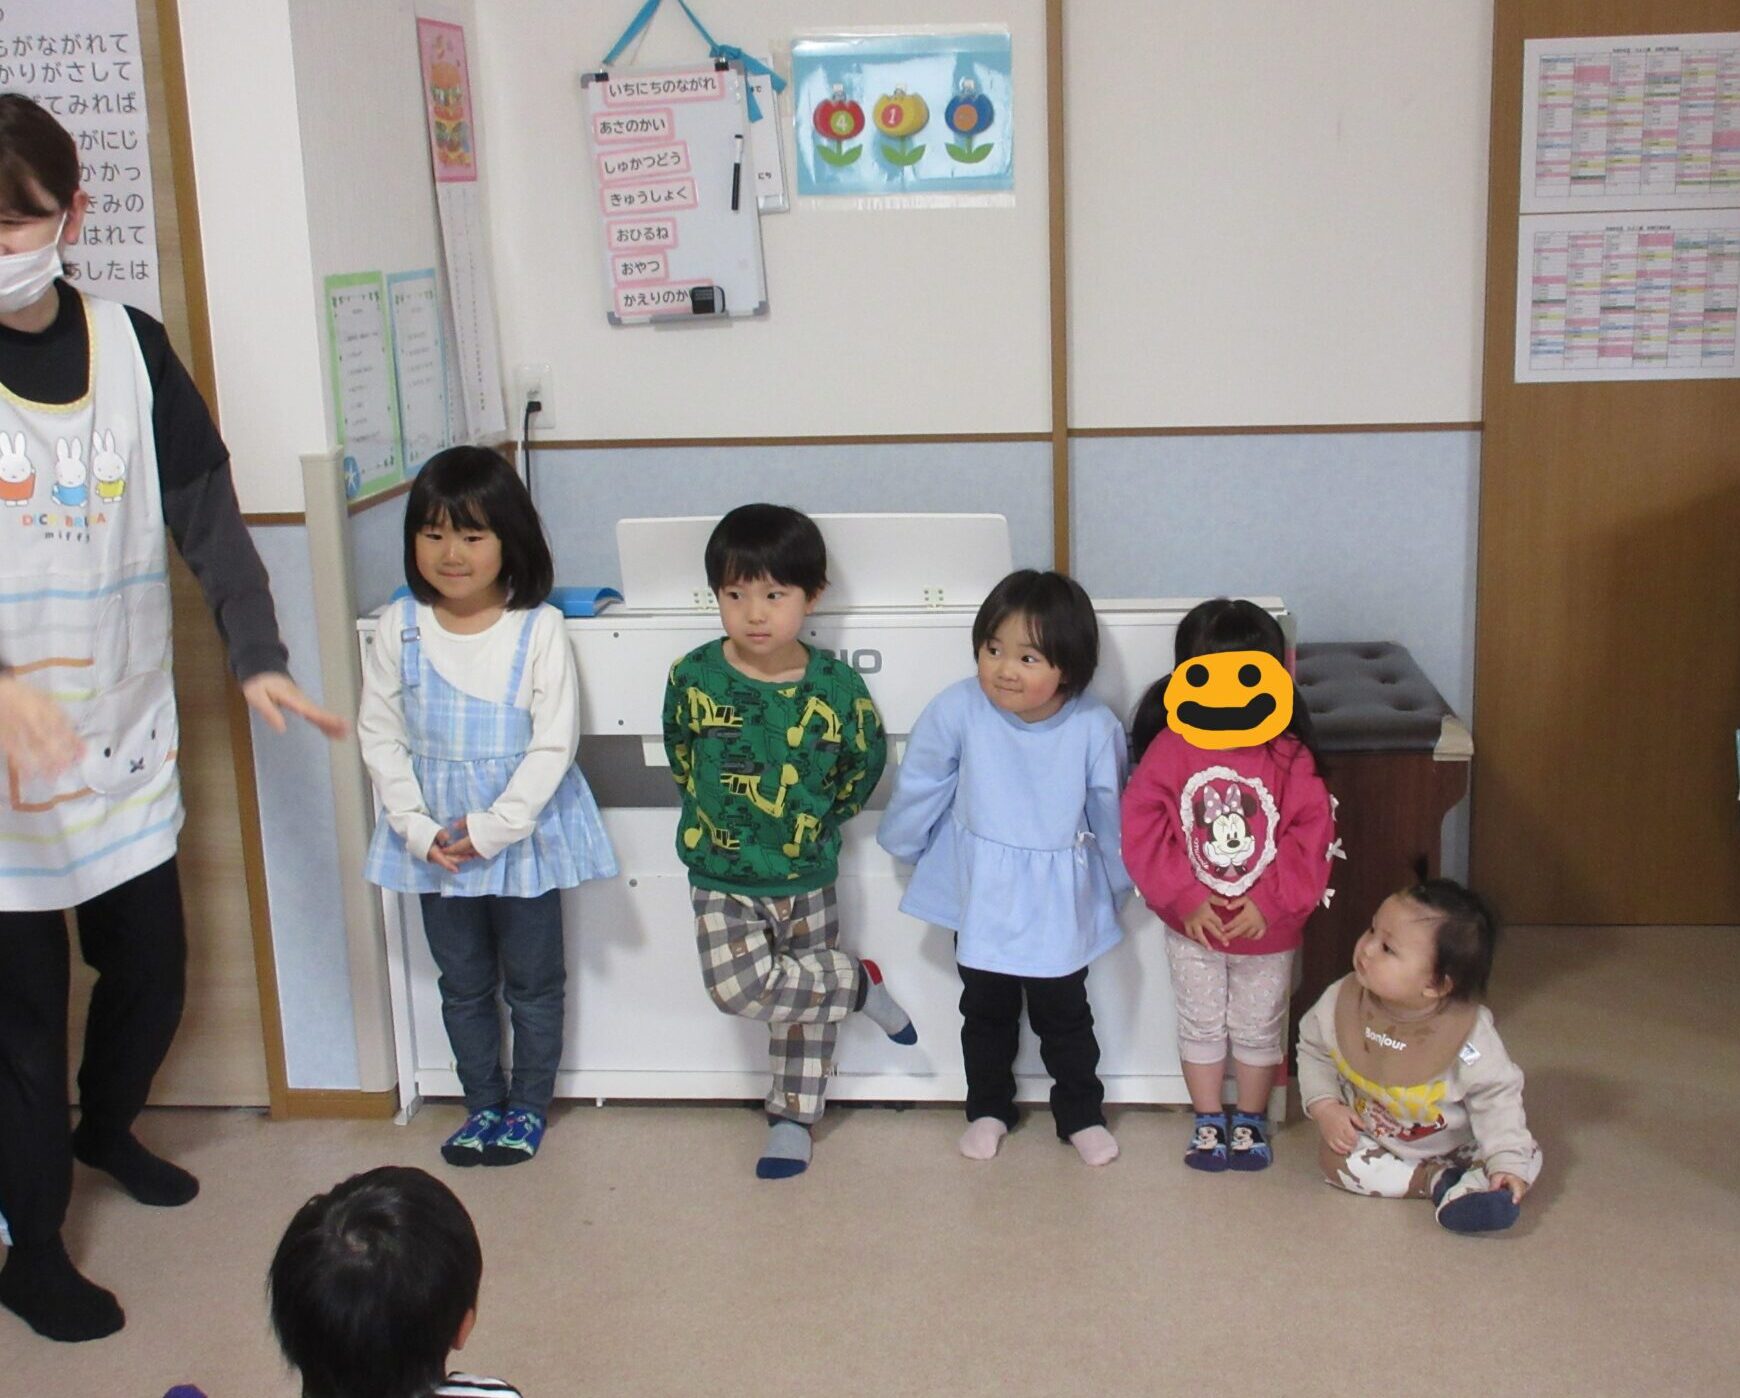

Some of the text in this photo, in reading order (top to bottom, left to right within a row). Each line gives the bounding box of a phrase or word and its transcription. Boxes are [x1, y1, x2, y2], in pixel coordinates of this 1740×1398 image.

[609, 77, 716, 98] いちにちのながれ
[32, 92, 137, 115] てみれば
[600, 118, 665, 135] あさのかい
[888, 108, 896, 125] 1
[71, 130, 138, 151] がにじ
[604, 151, 682, 175] しゅかつどう
[610, 186, 688, 207] きゅうしょく
[616, 226, 669, 242] おひるね
[621, 260, 660, 276] おやつ
[623, 289, 691, 308] かえりのか
[1365, 1026, 1407, 1051] Bonjour
